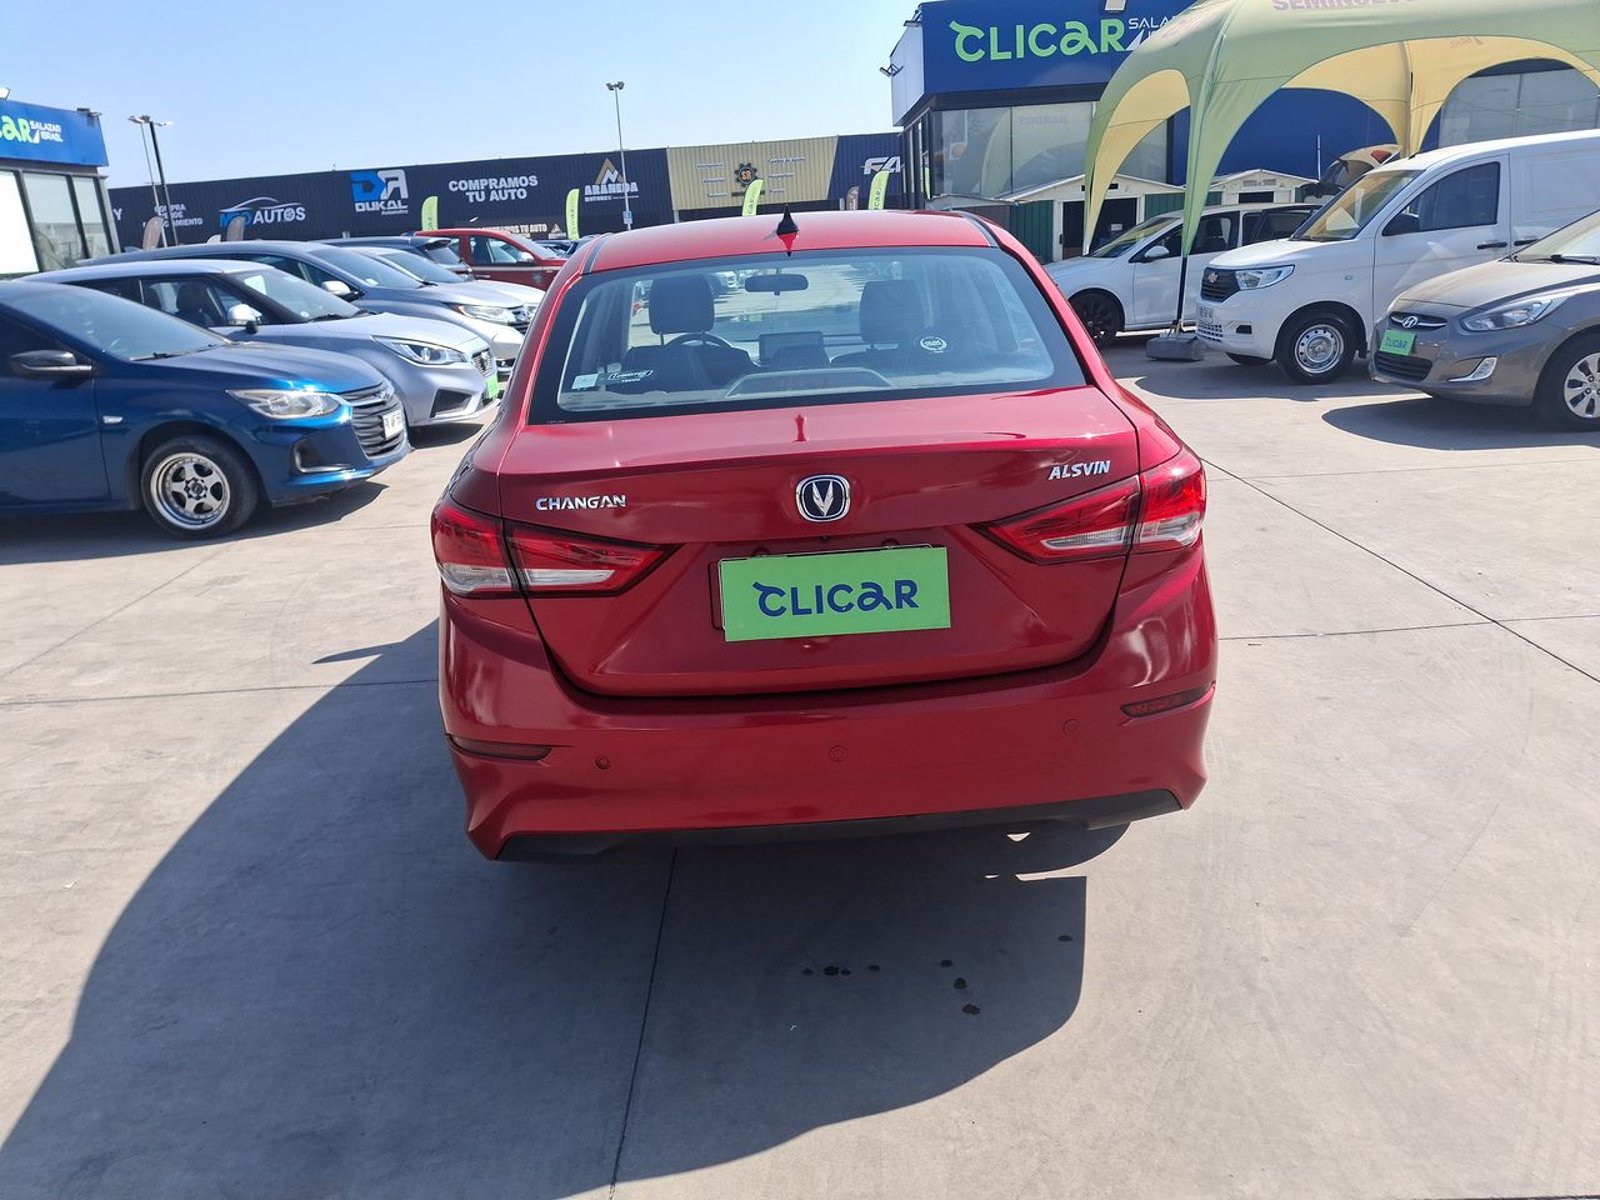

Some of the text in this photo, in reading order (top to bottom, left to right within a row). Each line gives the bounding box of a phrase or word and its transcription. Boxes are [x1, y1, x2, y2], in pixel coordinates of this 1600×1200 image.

[1128, 16, 1175, 29] SALA
[448, 175, 539, 192] COMPRAMOS
[465, 188, 528, 203] TU AUTO
[354, 200, 408, 212] DUKAL
[252, 206, 306, 225] AUTOS
[1047, 460, 1111, 480] ALSVIN
[535, 494, 627, 511] CHANGAN
